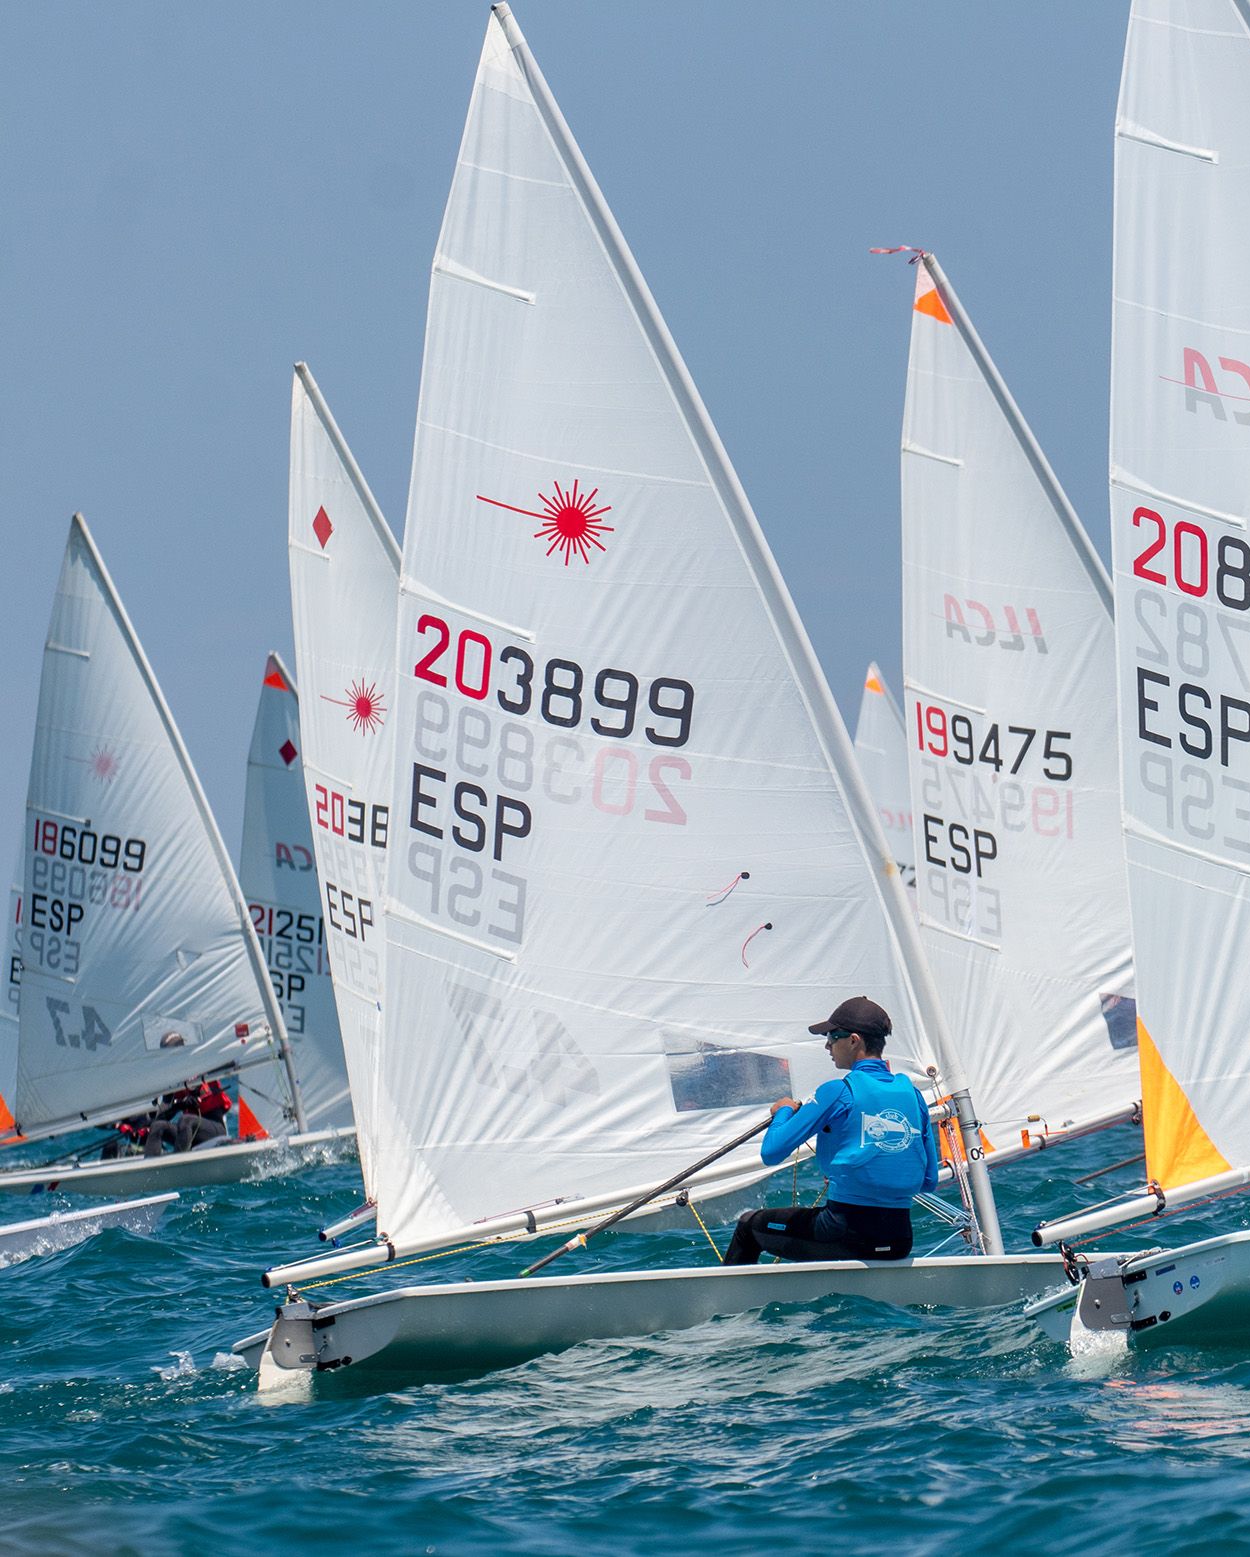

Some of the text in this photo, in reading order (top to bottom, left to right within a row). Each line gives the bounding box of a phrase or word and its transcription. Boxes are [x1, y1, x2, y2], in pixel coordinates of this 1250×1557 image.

[414, 614, 695, 748] 203899
[916, 701, 1073, 782] 199475
[315, 783, 389, 848] 2038
[410, 762, 532, 862] ESP
[33, 819, 147, 872] 186099
[923, 813, 998, 878] ESP
[31, 893, 84, 936] ESP
[326, 881, 374, 942] ESP
[270, 970, 305, 1001] SP
